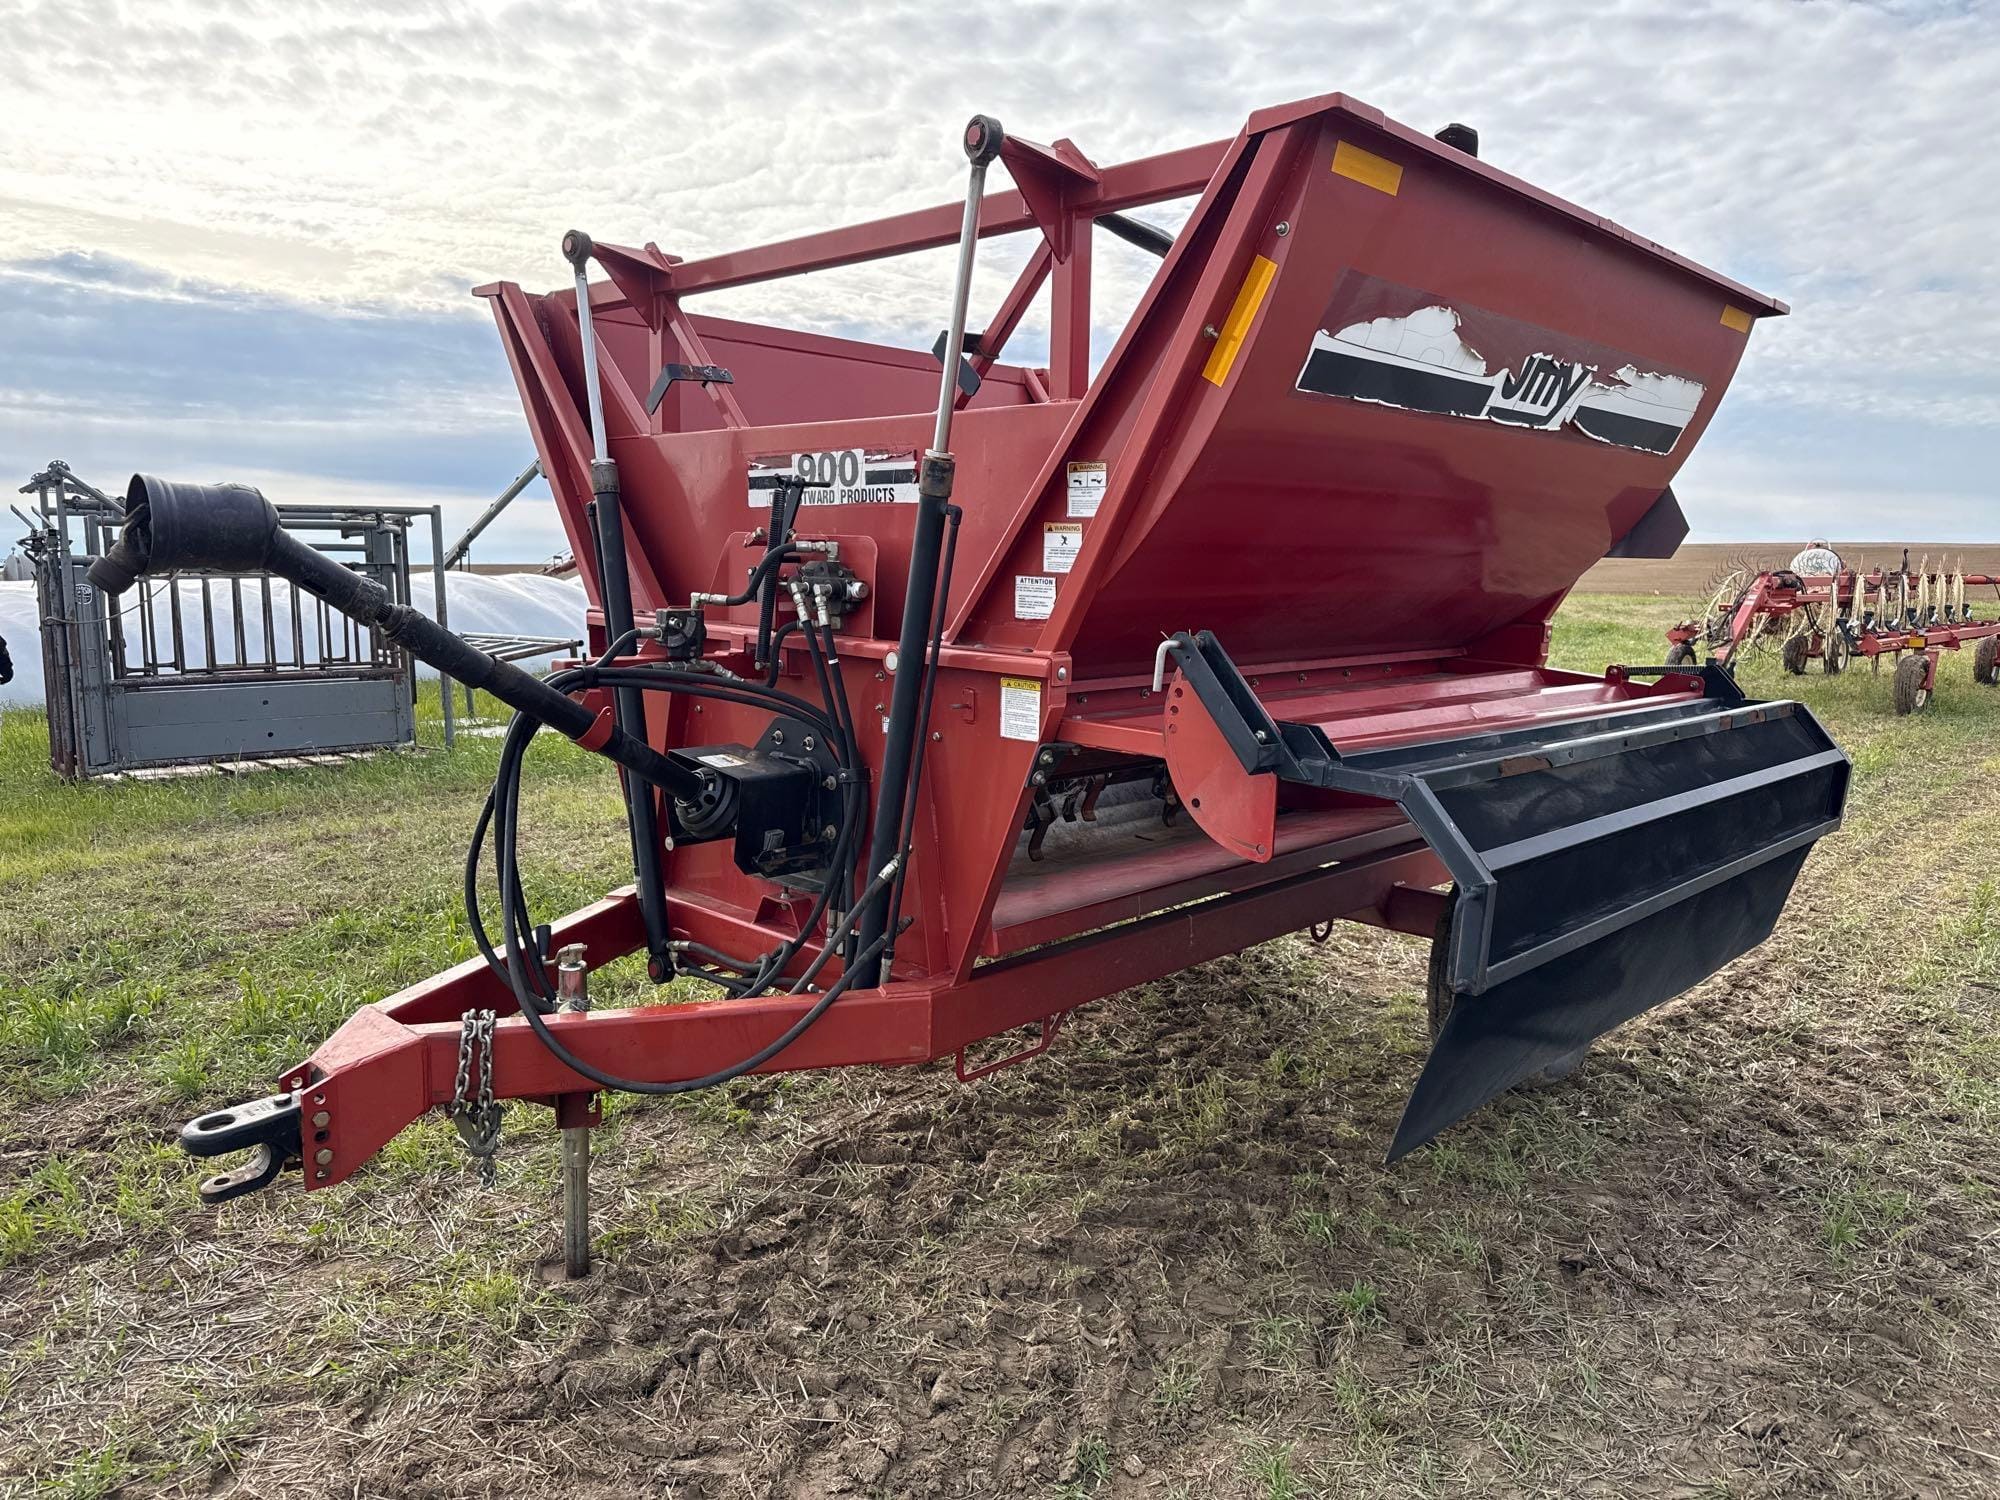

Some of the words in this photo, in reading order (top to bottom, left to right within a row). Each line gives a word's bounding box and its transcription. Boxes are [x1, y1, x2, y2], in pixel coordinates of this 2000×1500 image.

[797, 451, 859, 487] 900
[840, 487, 895, 504] PRODUCTS
[1020, 577, 1053, 585] ATTENTION
[1013, 681, 1036, 689] CAUTION
